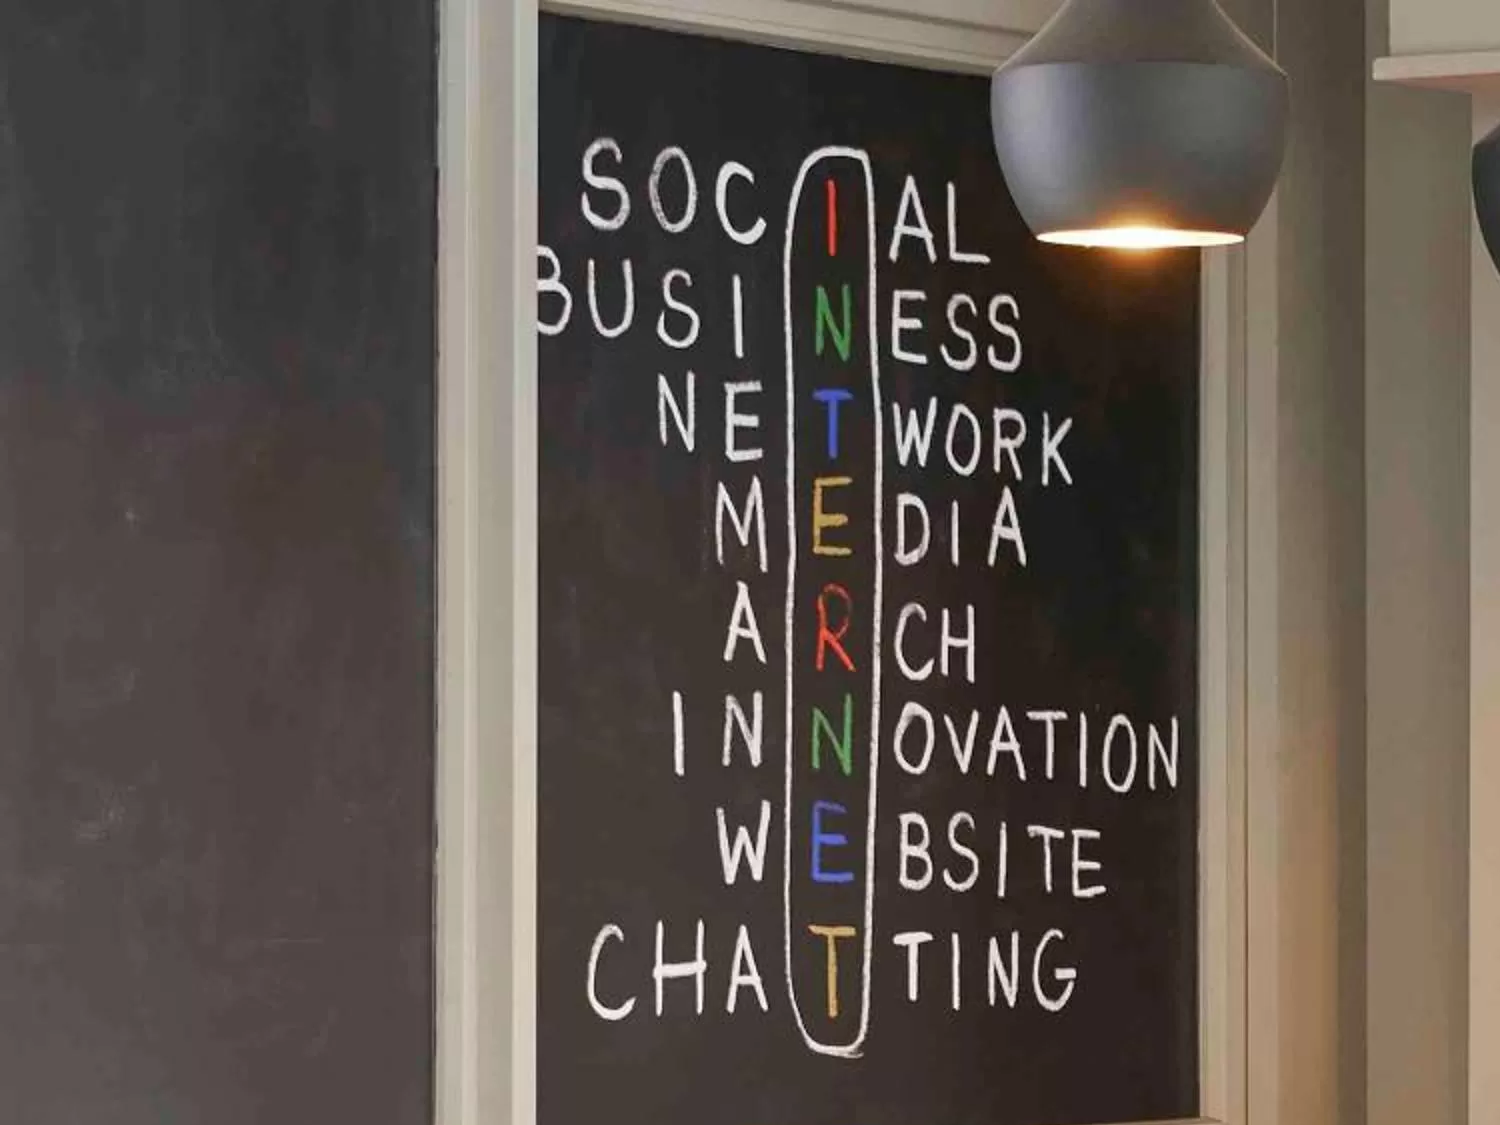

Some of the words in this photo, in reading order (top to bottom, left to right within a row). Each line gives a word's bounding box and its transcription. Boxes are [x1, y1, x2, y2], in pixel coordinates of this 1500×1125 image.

[580, 137, 991, 264] SOCIAL
[537, 245, 1023, 372] BUSINESS
[657, 370, 1074, 486] NETWORK
[714, 475, 1028, 573] MEDIA
[723, 580, 976, 684] ARCH
[672, 690, 1180, 793] INNOVATION
[715, 799, 1107, 898] WEBSITE
[586, 918, 1077, 1021] CHATTING
